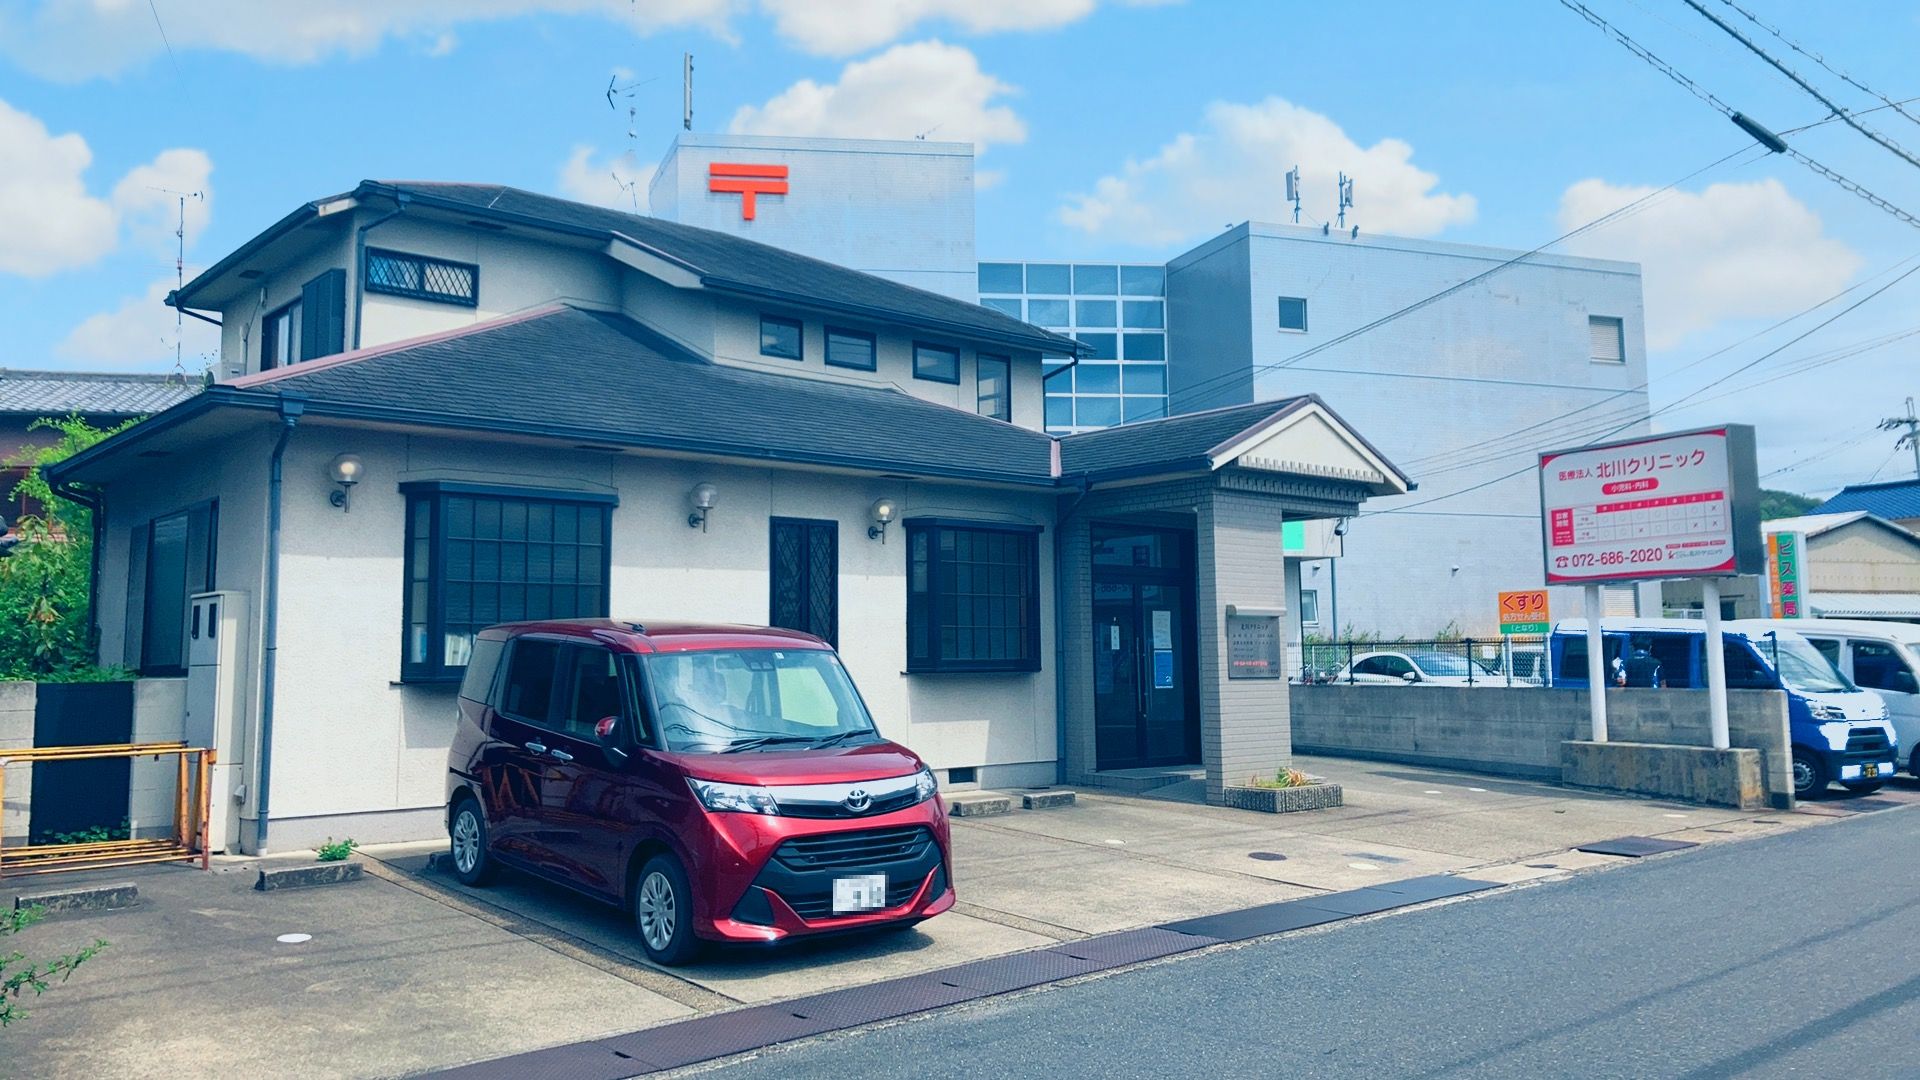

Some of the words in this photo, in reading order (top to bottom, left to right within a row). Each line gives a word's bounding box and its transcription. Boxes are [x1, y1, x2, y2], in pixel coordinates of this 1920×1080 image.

[1558, 468, 1594, 481] 医療法人
[1596, 449, 1705, 479] 北川クリニック
[1571, 548, 1663, 568] 072-686-2020
[1503, 594, 1544, 610] くすり
